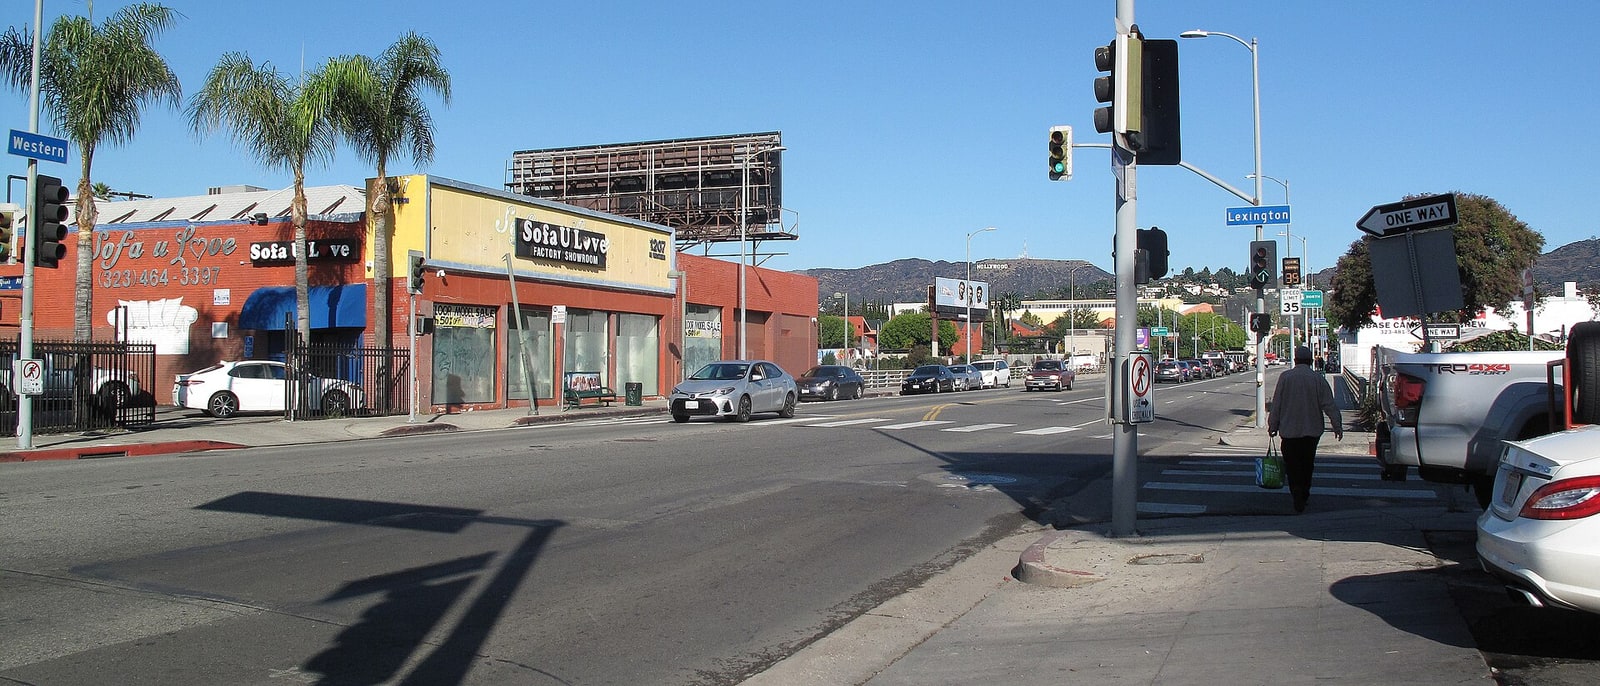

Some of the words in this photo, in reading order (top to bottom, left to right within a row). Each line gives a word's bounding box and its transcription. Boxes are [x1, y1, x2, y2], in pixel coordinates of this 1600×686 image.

[13, 135, 65, 158] Western
[1228, 210, 1289, 224] Lexington
[1385, 211, 1413, 226] ONE
[1416, 205, 1445, 221] WAY
[522, 219, 558, 246] Sofa
[560, 227, 571, 247] U
[92, 230, 145, 270] Sofa
[250, 242, 288, 260] Sofa
[533, 246, 562, 260] FACTORY
[564, 252, 599, 265] SHOWROOM
[475, 308, 496, 319] SALE
[1283, 302, 1299, 312] 35
[1366, 321, 1391, 329] BASE
[1428, 363, 1468, 374] TRD
